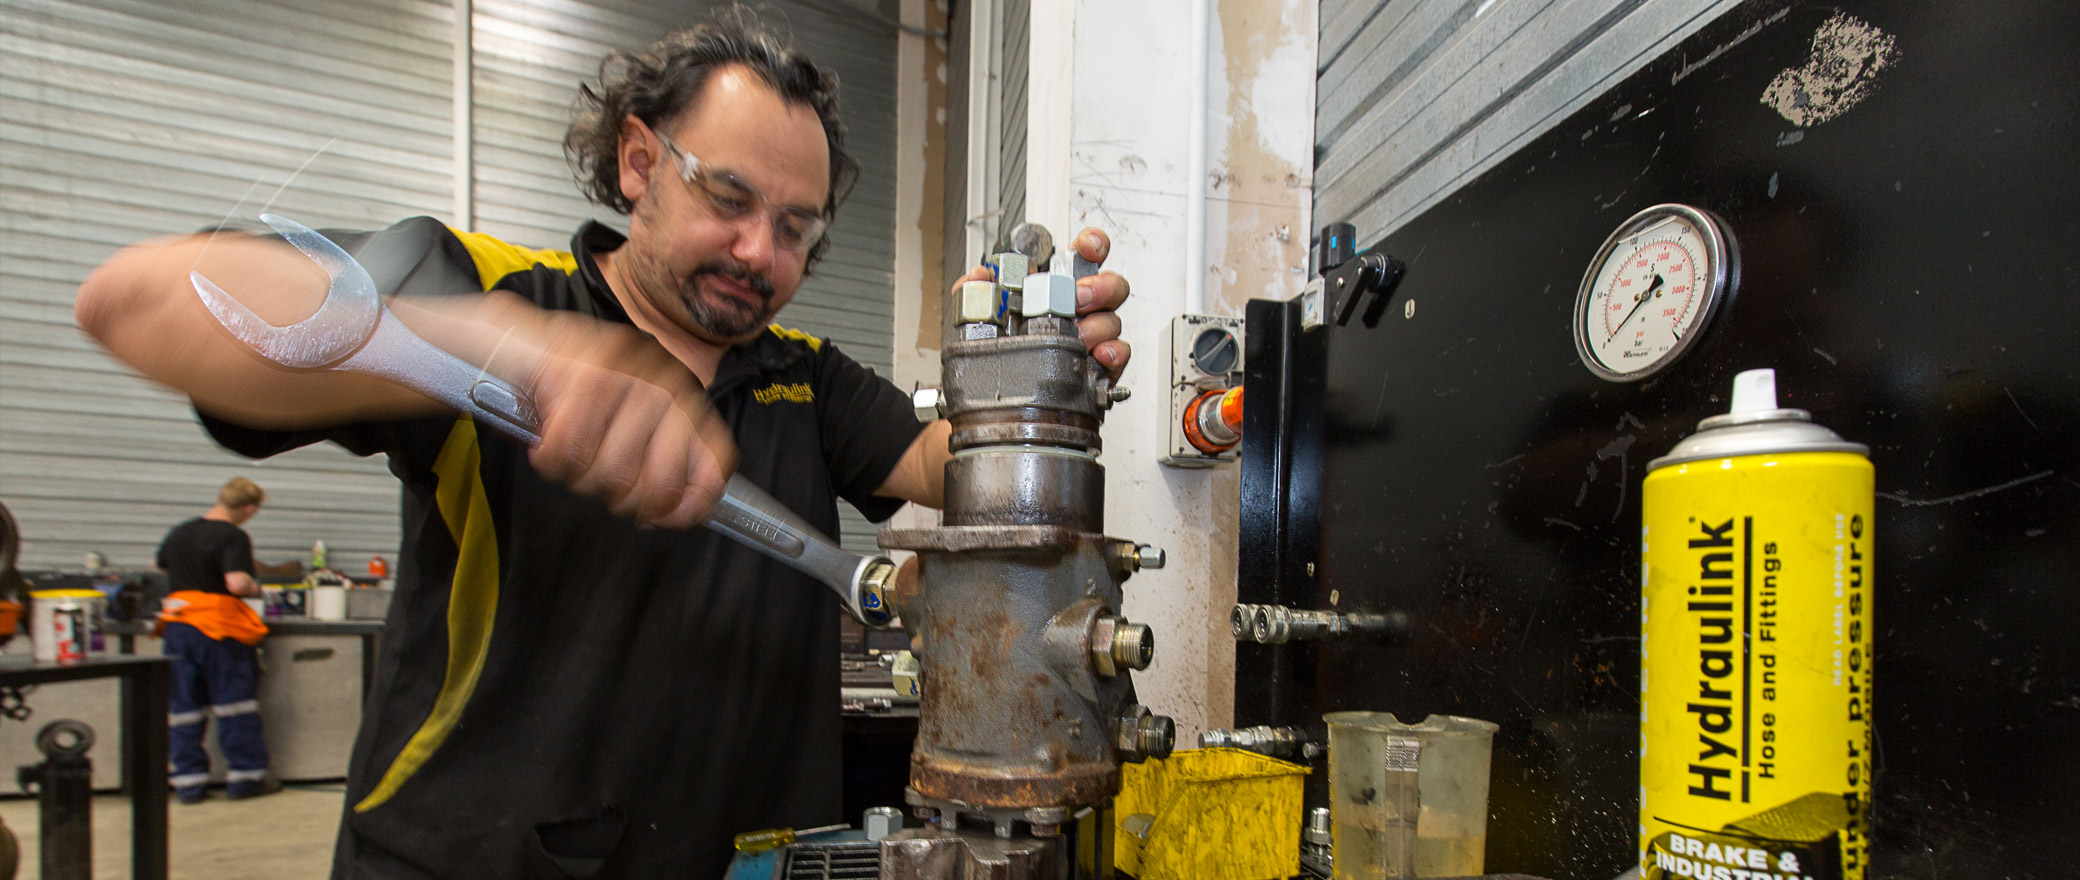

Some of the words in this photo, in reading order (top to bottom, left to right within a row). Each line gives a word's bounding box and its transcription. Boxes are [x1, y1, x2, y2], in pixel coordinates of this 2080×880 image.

[1682, 226, 1691, 235] 150
[1636, 259, 1648, 268] 1500
[1656, 252, 1670, 262] 2000
[1669, 264, 1682, 274] 2500
[1620, 279, 1632, 288] 1000
[1672, 286, 1685, 295] 3000
[1613, 303, 1622, 311] 500
[1662, 308, 1676, 317] 3500
[1835, 513, 1845, 540] USE
[1834, 544, 1844, 598] BEFORE
[1759, 541, 1781, 642] Fittings
[1833, 603, 1843, 645] LABEL
[1848, 513, 1864, 722] pressure
[1687, 517, 1737, 801] Hydraulink
[1833, 649, 1843, 686] READ
[1759, 654, 1776, 702] and
[1759, 712, 1776, 779] Hose
[1843, 740, 1861, 870] under
[1670, 834, 1768, 870] BRAKE
[1777, 851, 1801, 873] &
